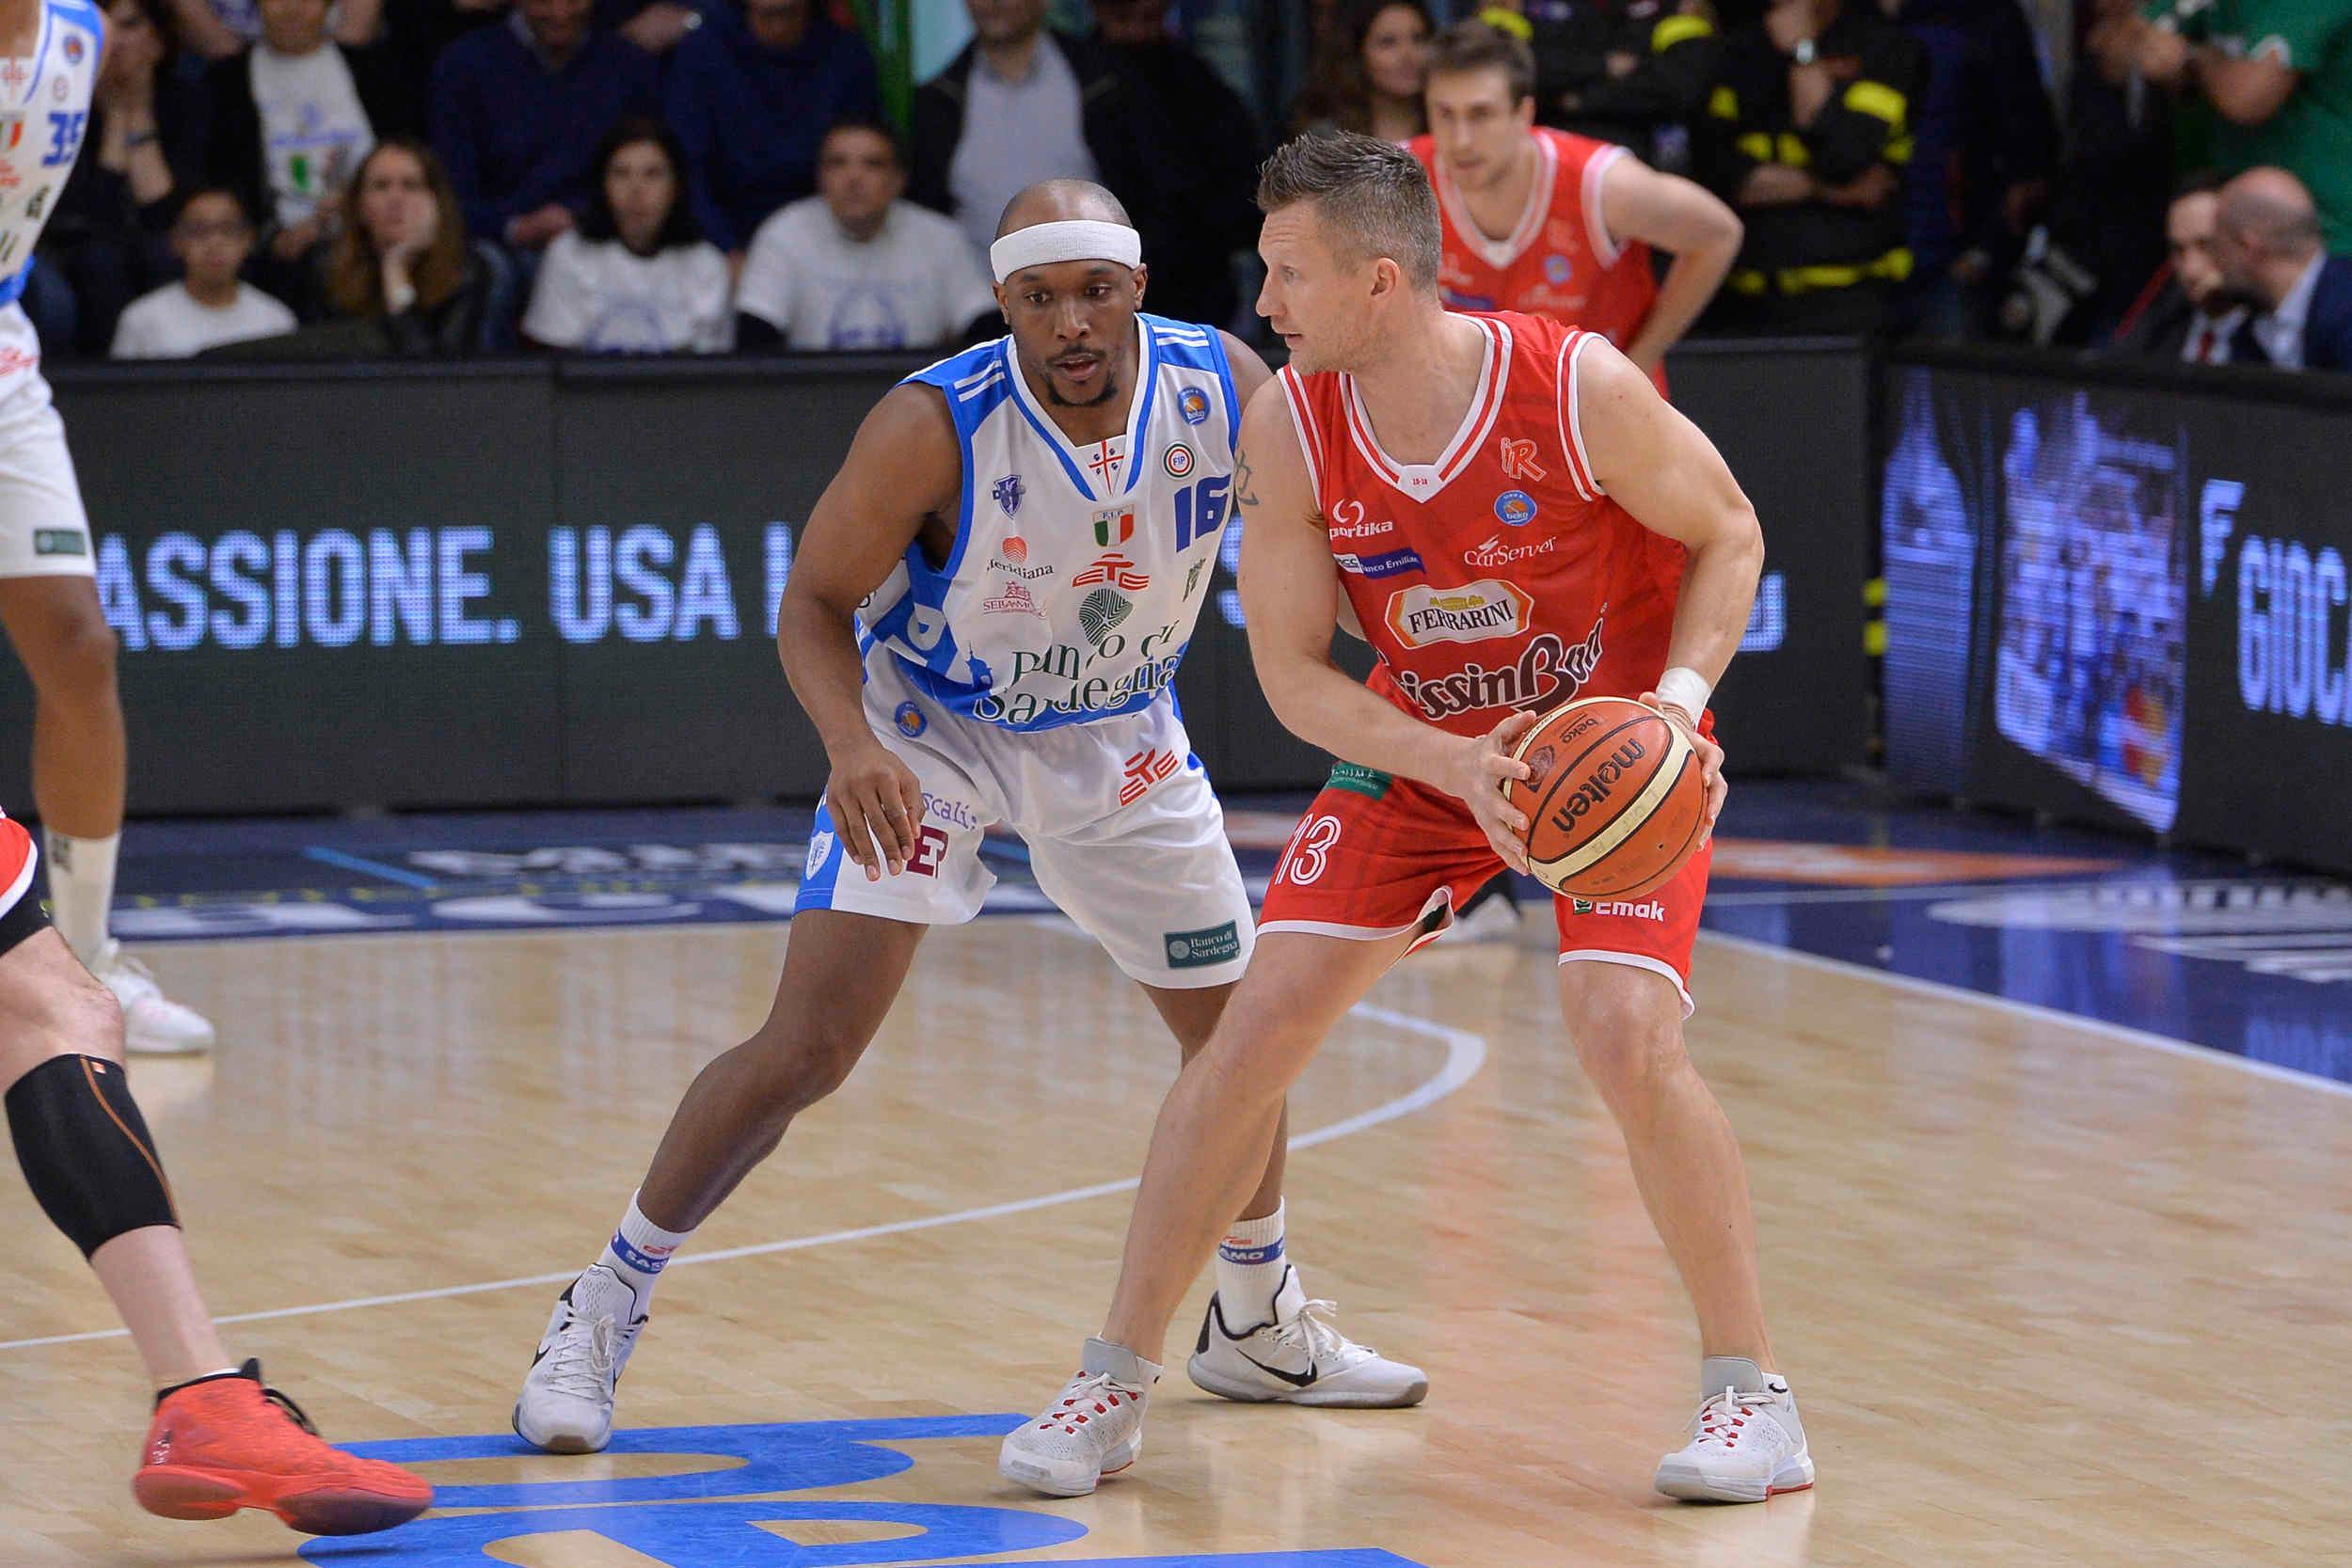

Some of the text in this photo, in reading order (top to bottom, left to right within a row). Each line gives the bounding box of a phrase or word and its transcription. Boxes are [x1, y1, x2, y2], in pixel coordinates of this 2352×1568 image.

[1173, 473, 1232, 553] 16
[1464, 534, 1557, 567] CarServer
[546, 521, 741, 644] USA
[1408, 599, 1515, 634] FERRARINI
[1562, 718, 1599, 744] beko
[1551, 738, 1646, 833] molten
[1274, 812, 1342, 885] 13
[1595, 900, 1665, 922] Emak
